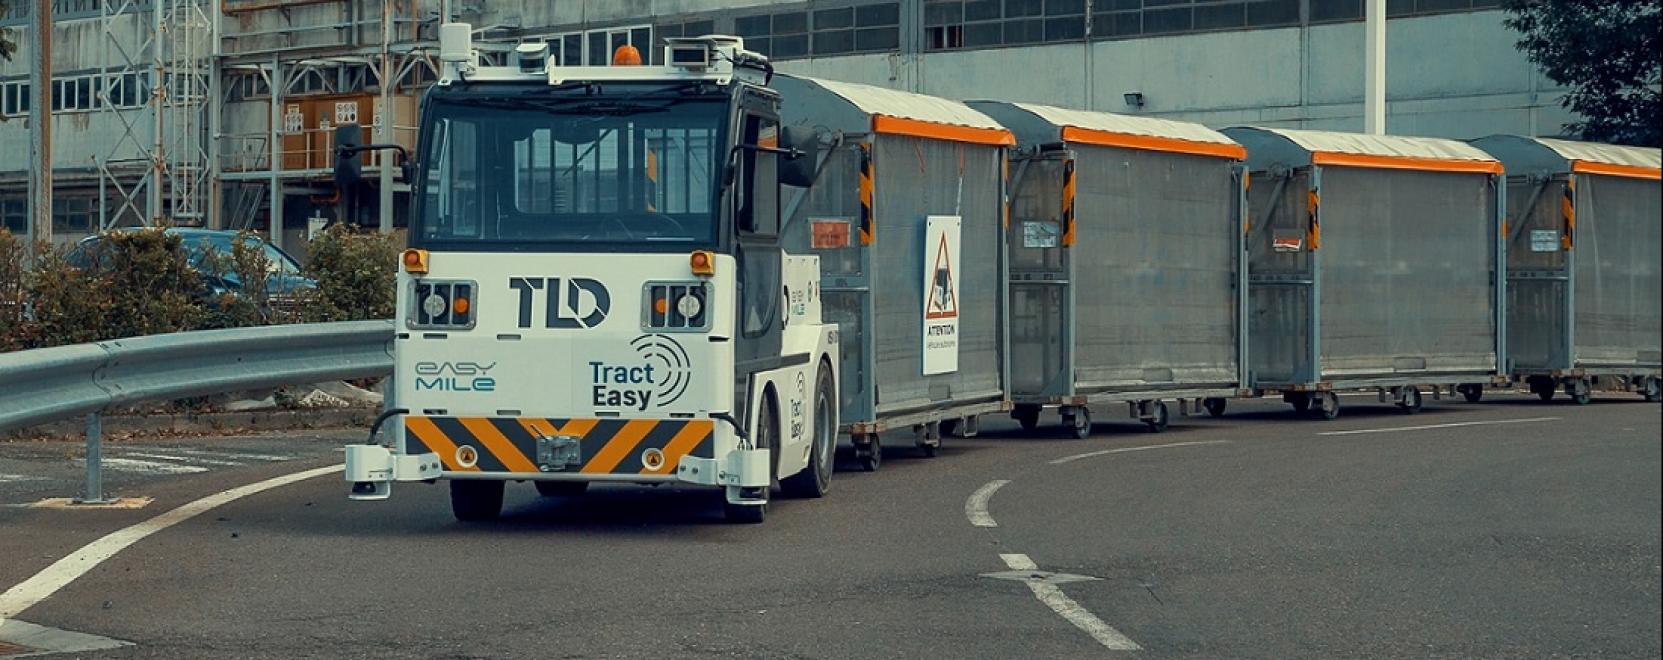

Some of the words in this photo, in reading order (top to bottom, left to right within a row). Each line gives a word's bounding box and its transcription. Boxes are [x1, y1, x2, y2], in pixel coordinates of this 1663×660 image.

[509, 277, 611, 328] TLD
[589, 361, 655, 384] Tract
[592, 386, 652, 411] Easy
